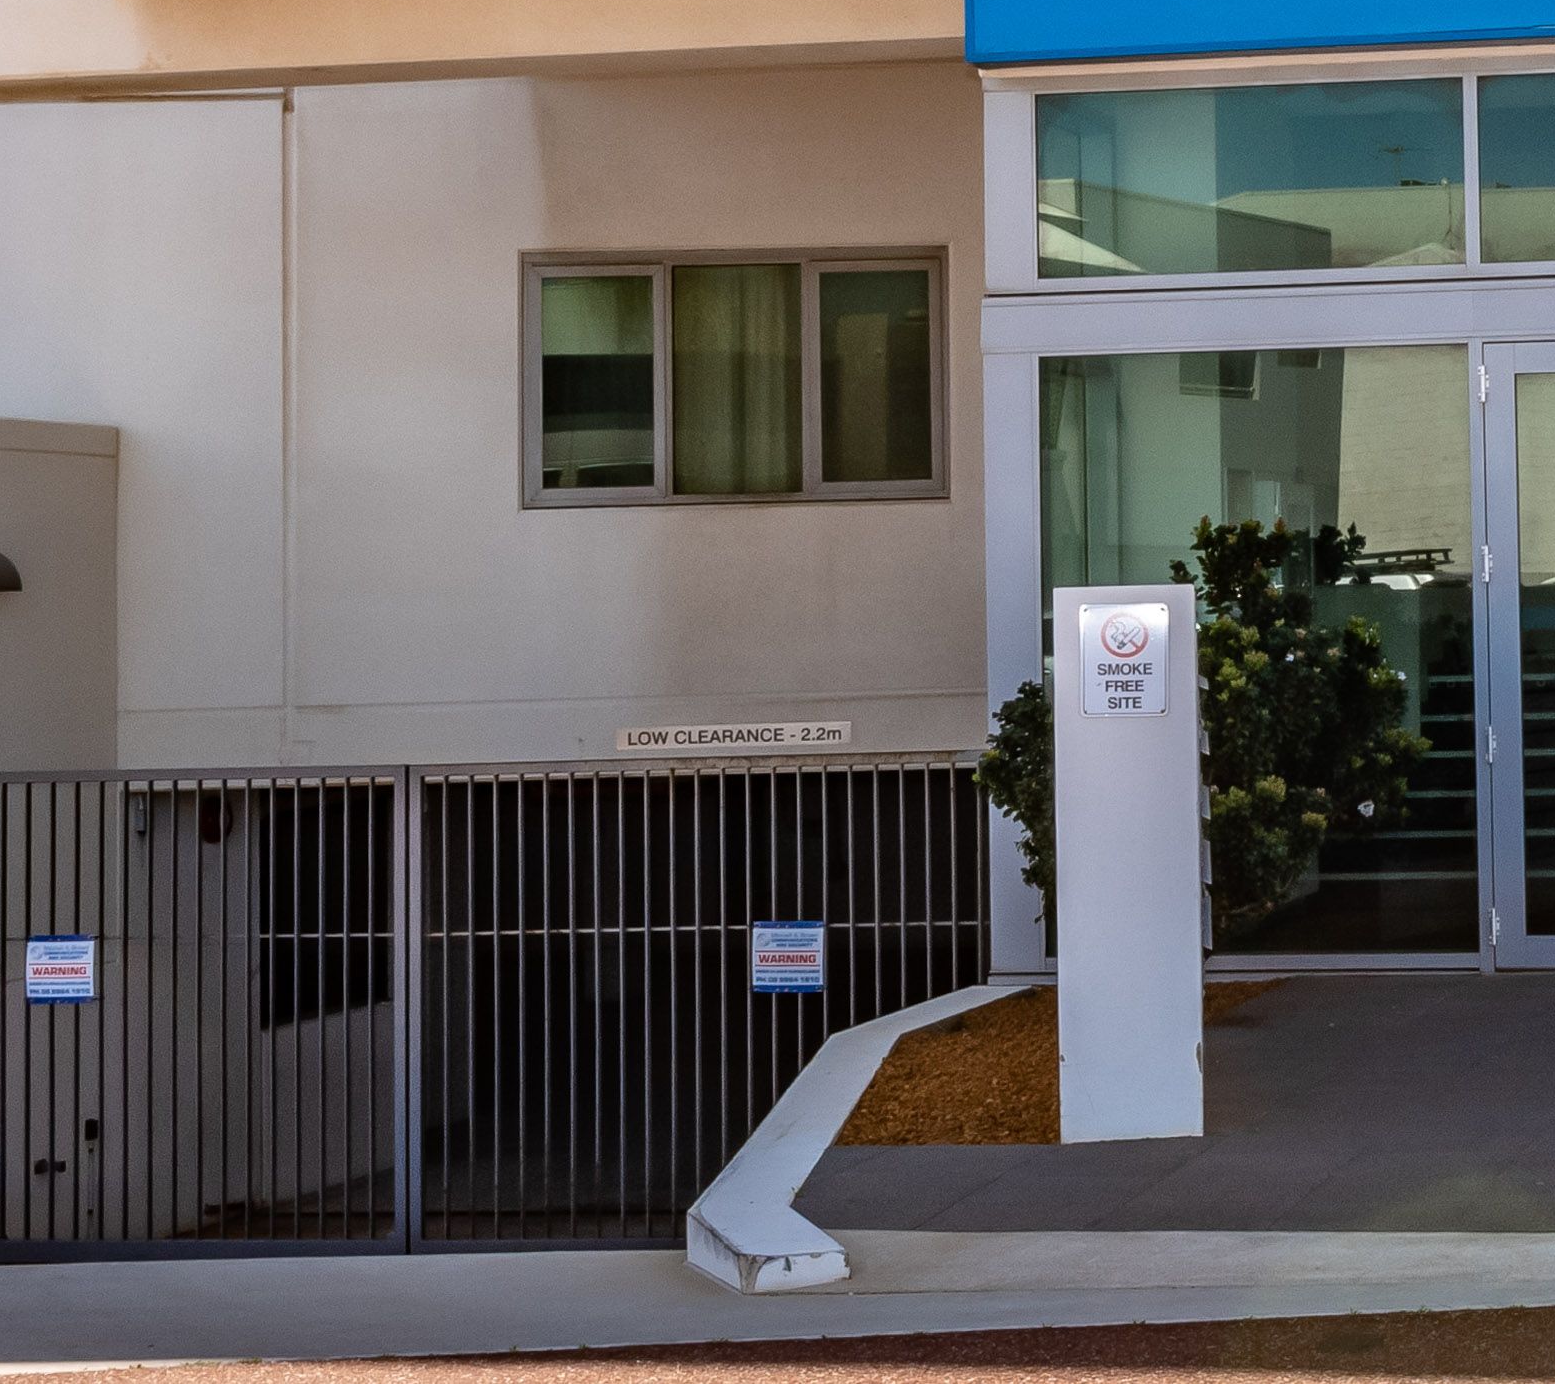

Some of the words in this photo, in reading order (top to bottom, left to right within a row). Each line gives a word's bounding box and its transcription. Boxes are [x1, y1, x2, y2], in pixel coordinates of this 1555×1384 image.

[1097, 663, 1153, 676] SMOKE
[1105, 680, 1145, 693] FREE
[1107, 696, 1143, 709] SITE
[627, 731, 668, 746] LOW
[674, 728, 785, 745] CLEARANCE
[800, 727, 843, 741] 2.2m
[758, 954, 817, 964] WARNING
[32, 966, 87, 976] WARNING
